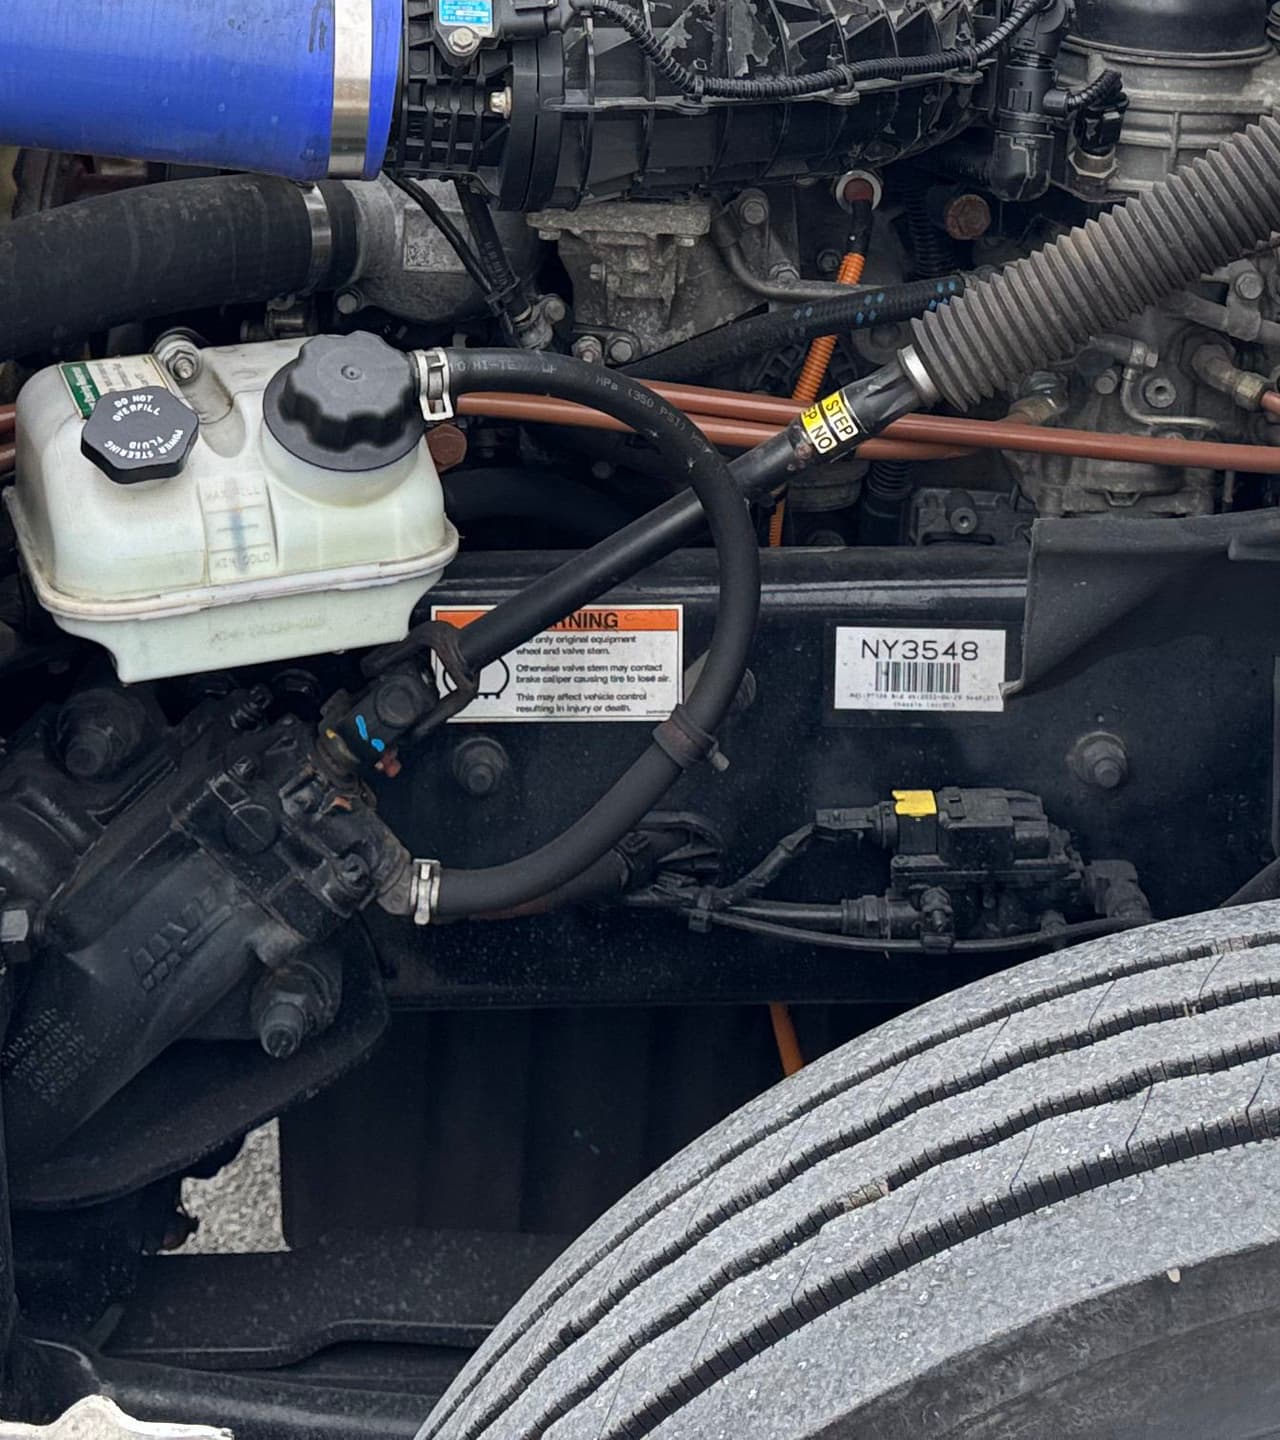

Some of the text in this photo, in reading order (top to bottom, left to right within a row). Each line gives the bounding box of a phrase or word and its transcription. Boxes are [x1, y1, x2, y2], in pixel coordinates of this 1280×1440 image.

[113, 394, 154, 409] DO NOT
[627, 388, 655, 409] (350
[112, 403, 161, 422] OVERFILL
[825, 399, 854, 436] STEP
[129, 436, 164, 450] FLUID
[810, 425, 833, 449] NO
[104, 429, 184, 460] POWER STEERING
[535, 635, 554, 646] only
[555, 635, 589, 646] original
[590, 635, 636, 646] equipment
[516, 647, 541, 655] wheel
[542, 646, 561, 655] and
[562, 646, 585, 655] valve
[861, 639, 979, 661] NY3548
[515, 664, 663, 675] Otherwise valve stem may contact
[516, 675, 541, 684] brake
[542, 675, 572, 685] caliper
[573, 675, 609, 685] causing
[610, 675, 625, 683] tire
[626, 675, 636, 683] to
[638, 675, 656, 683] lose
[516, 692, 647, 703] This may affect vehicle control
[516, 704, 555, 714] resulting
[556, 704, 565, 712] in
[566, 704, 592, 714] injury
[604, 704, 631, 713] death.
